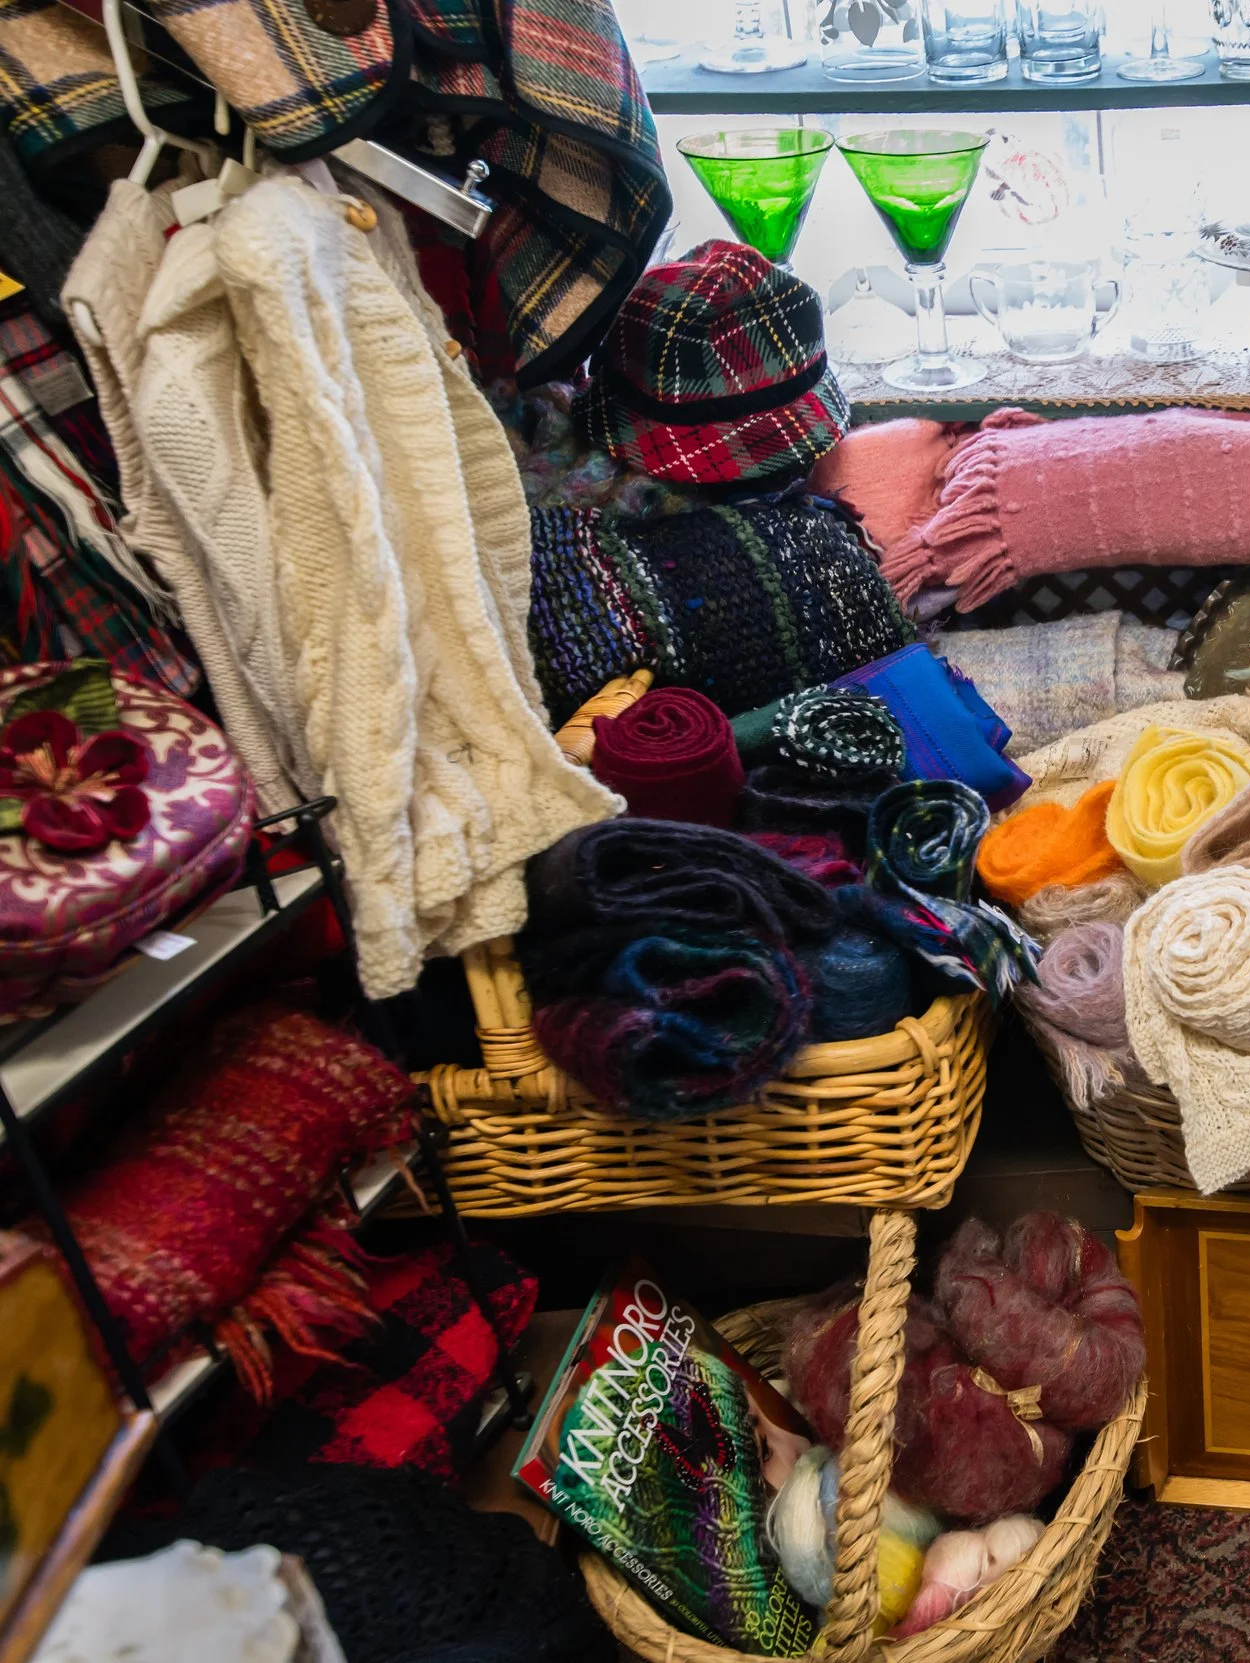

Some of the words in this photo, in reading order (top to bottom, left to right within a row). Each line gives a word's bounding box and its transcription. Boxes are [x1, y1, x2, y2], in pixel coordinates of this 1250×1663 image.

[560, 1379, 624, 1486] KNIT
[598, 1280, 667, 1399] NORO
[601, 1305, 696, 1513] ACCESSORIES
[538, 1478, 571, 1505] KNIT
[564, 1502, 602, 1535] NORO
[597, 1534, 674, 1601] ACCESSORIES
[745, 1610, 760, 1640] 30
[759, 1566, 788, 1650] COLORF
[790, 1615, 812, 1659] NITS
